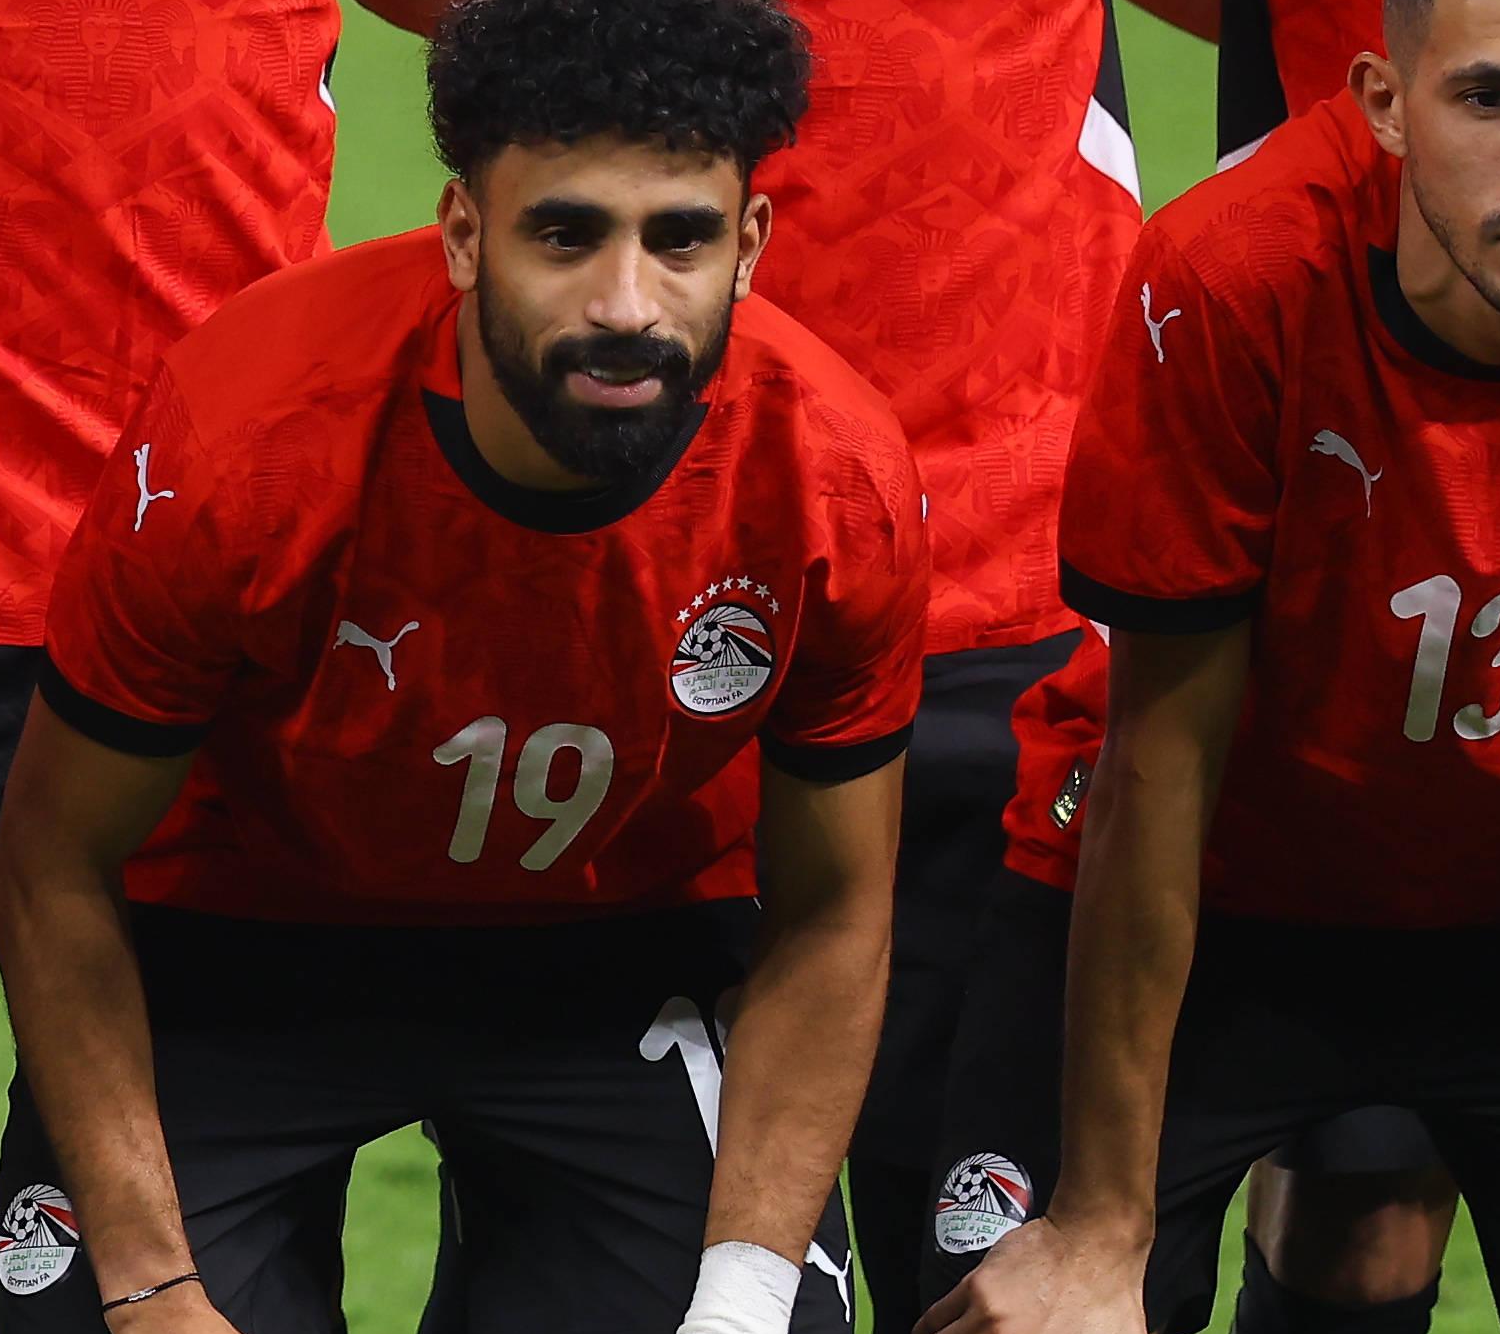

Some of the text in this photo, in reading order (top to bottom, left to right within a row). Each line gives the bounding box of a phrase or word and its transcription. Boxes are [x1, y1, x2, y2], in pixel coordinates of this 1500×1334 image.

[692, 690, 744, 706] EGYPTIAN FA
[433, 715, 614, 871] 19
[944, 1236, 988, 1247] EGYPTIAN FA
[7, 1272, 51, 1288] EGYPTIAN FA
